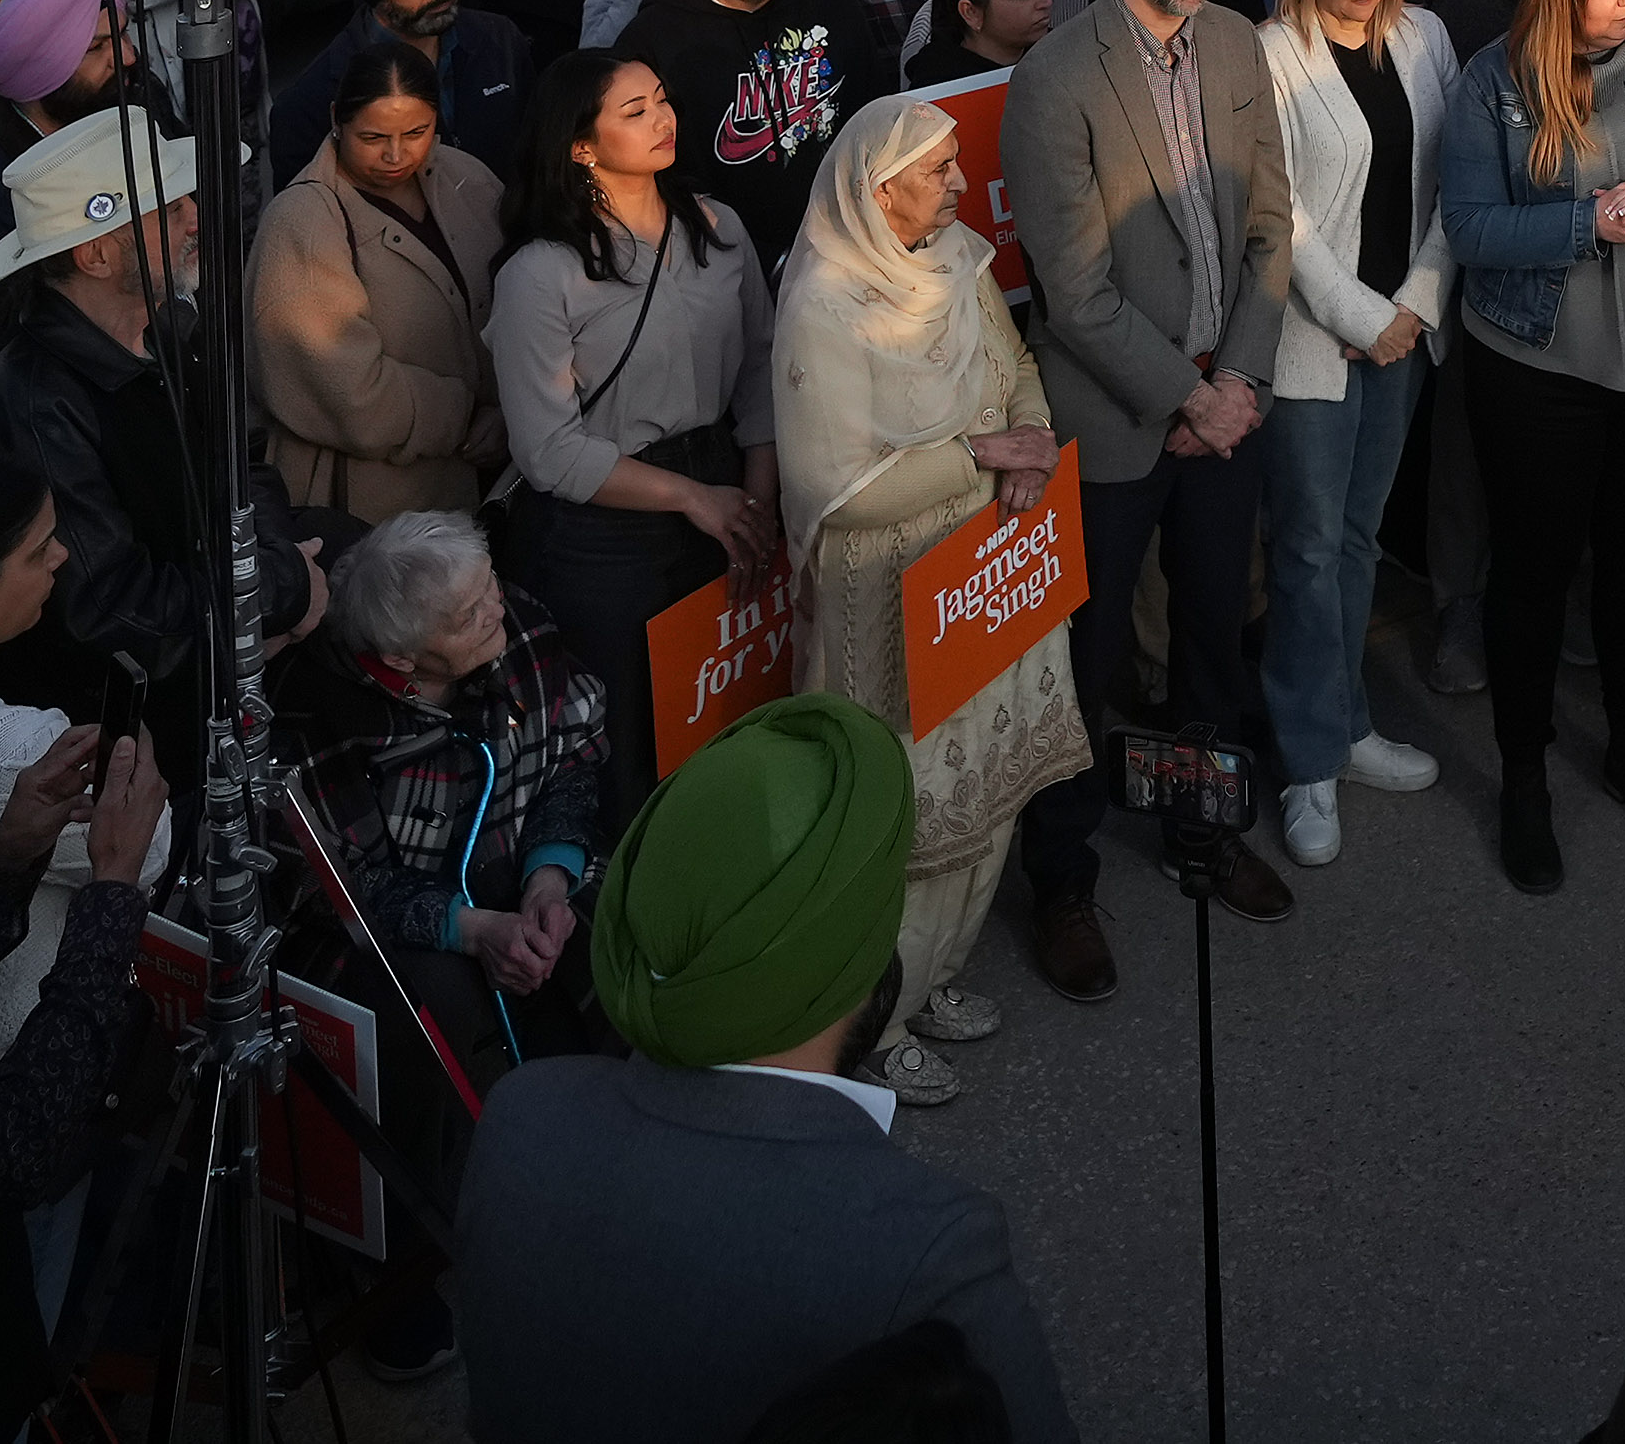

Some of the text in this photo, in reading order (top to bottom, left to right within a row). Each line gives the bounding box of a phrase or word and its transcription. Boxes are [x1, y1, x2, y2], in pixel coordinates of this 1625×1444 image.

[734, 57, 822, 122] NIKE
[985, 517, 1020, 554] NDP
[932, 508, 1059, 643] Jagmeet
[985, 549, 1063, 634] Singh
[717, 601, 760, 650] In
[687, 641, 752, 725] for
[135, 949, 200, 990] e-Elect
